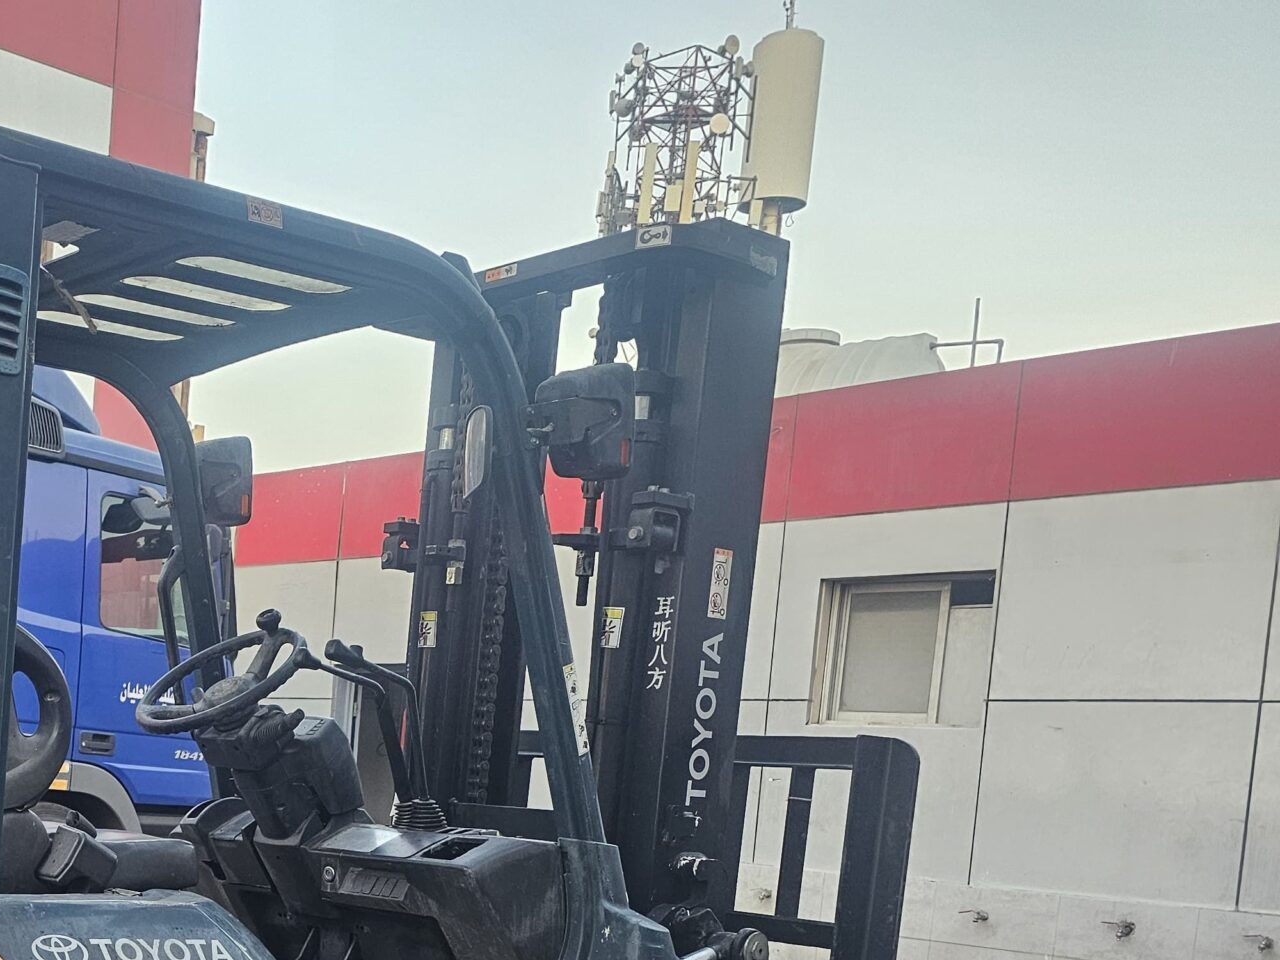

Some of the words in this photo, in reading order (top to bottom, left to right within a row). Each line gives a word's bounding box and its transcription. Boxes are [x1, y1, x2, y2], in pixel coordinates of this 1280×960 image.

[646, 595, 675, 691] 耳听八方
[685, 632, 724, 807] TOYOTA
